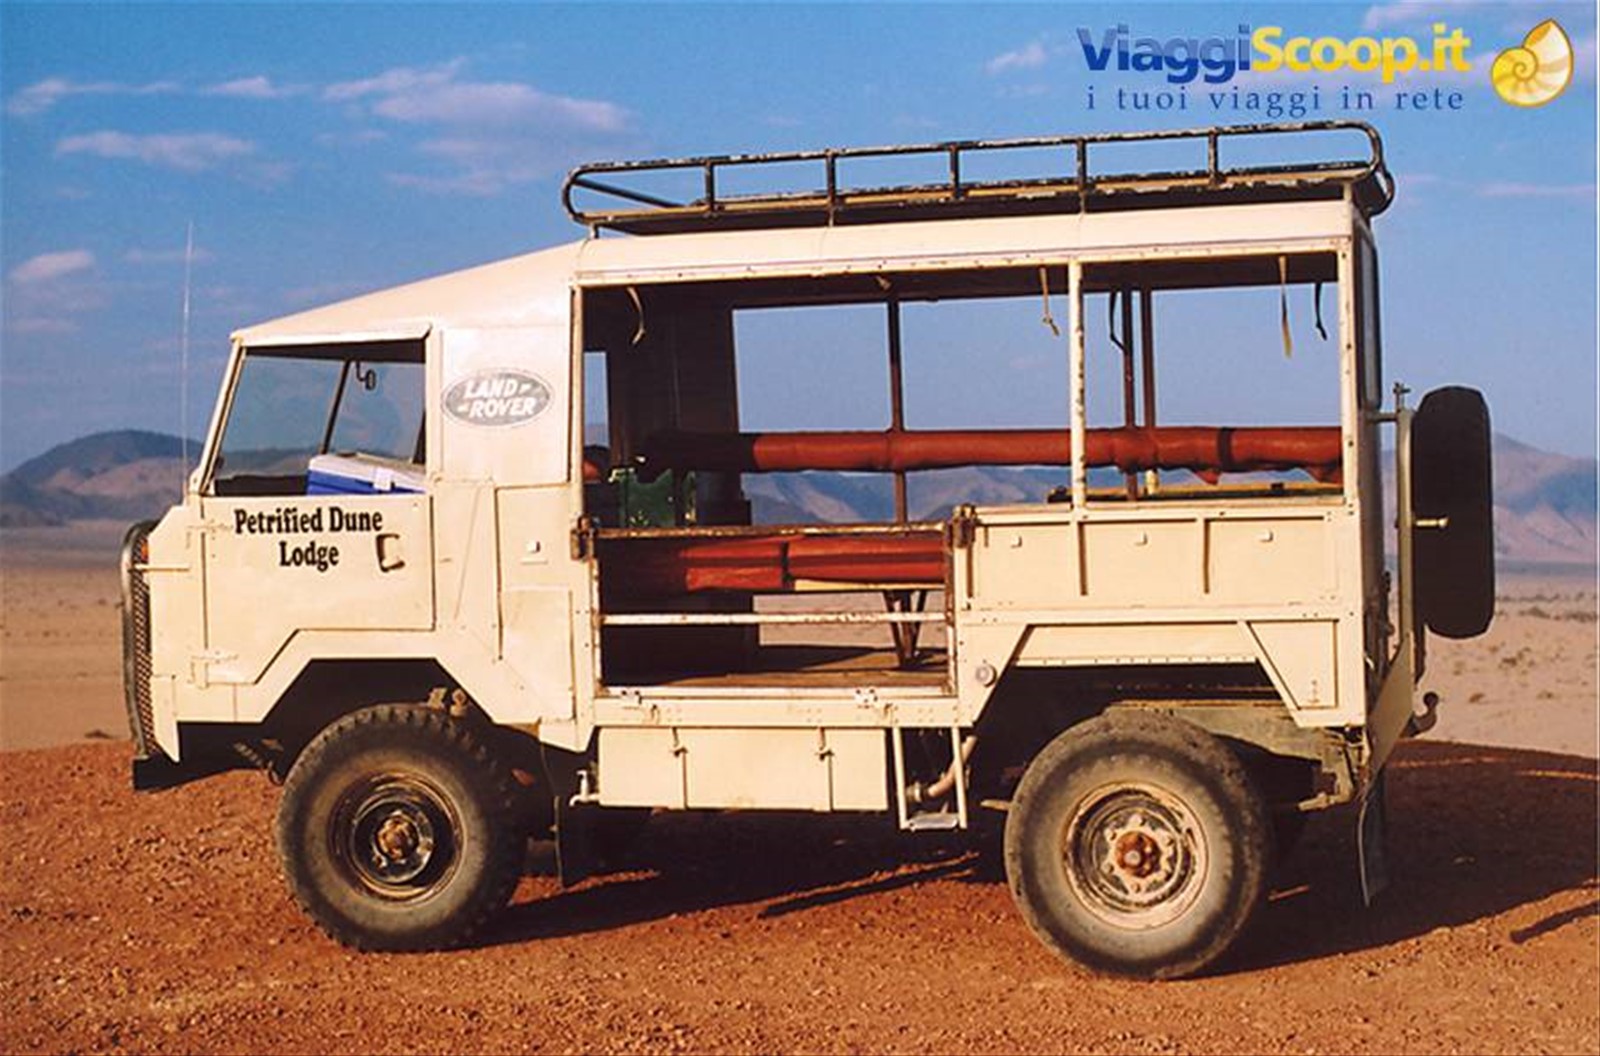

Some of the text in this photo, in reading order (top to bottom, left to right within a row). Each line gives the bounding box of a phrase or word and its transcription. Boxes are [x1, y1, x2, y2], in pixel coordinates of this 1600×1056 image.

[463, 379, 519, 399] LAND
[469, 397, 537, 419] ROVER
[233, 506, 383, 534] Petrified Dune
[279, 540, 340, 573] Lodge
